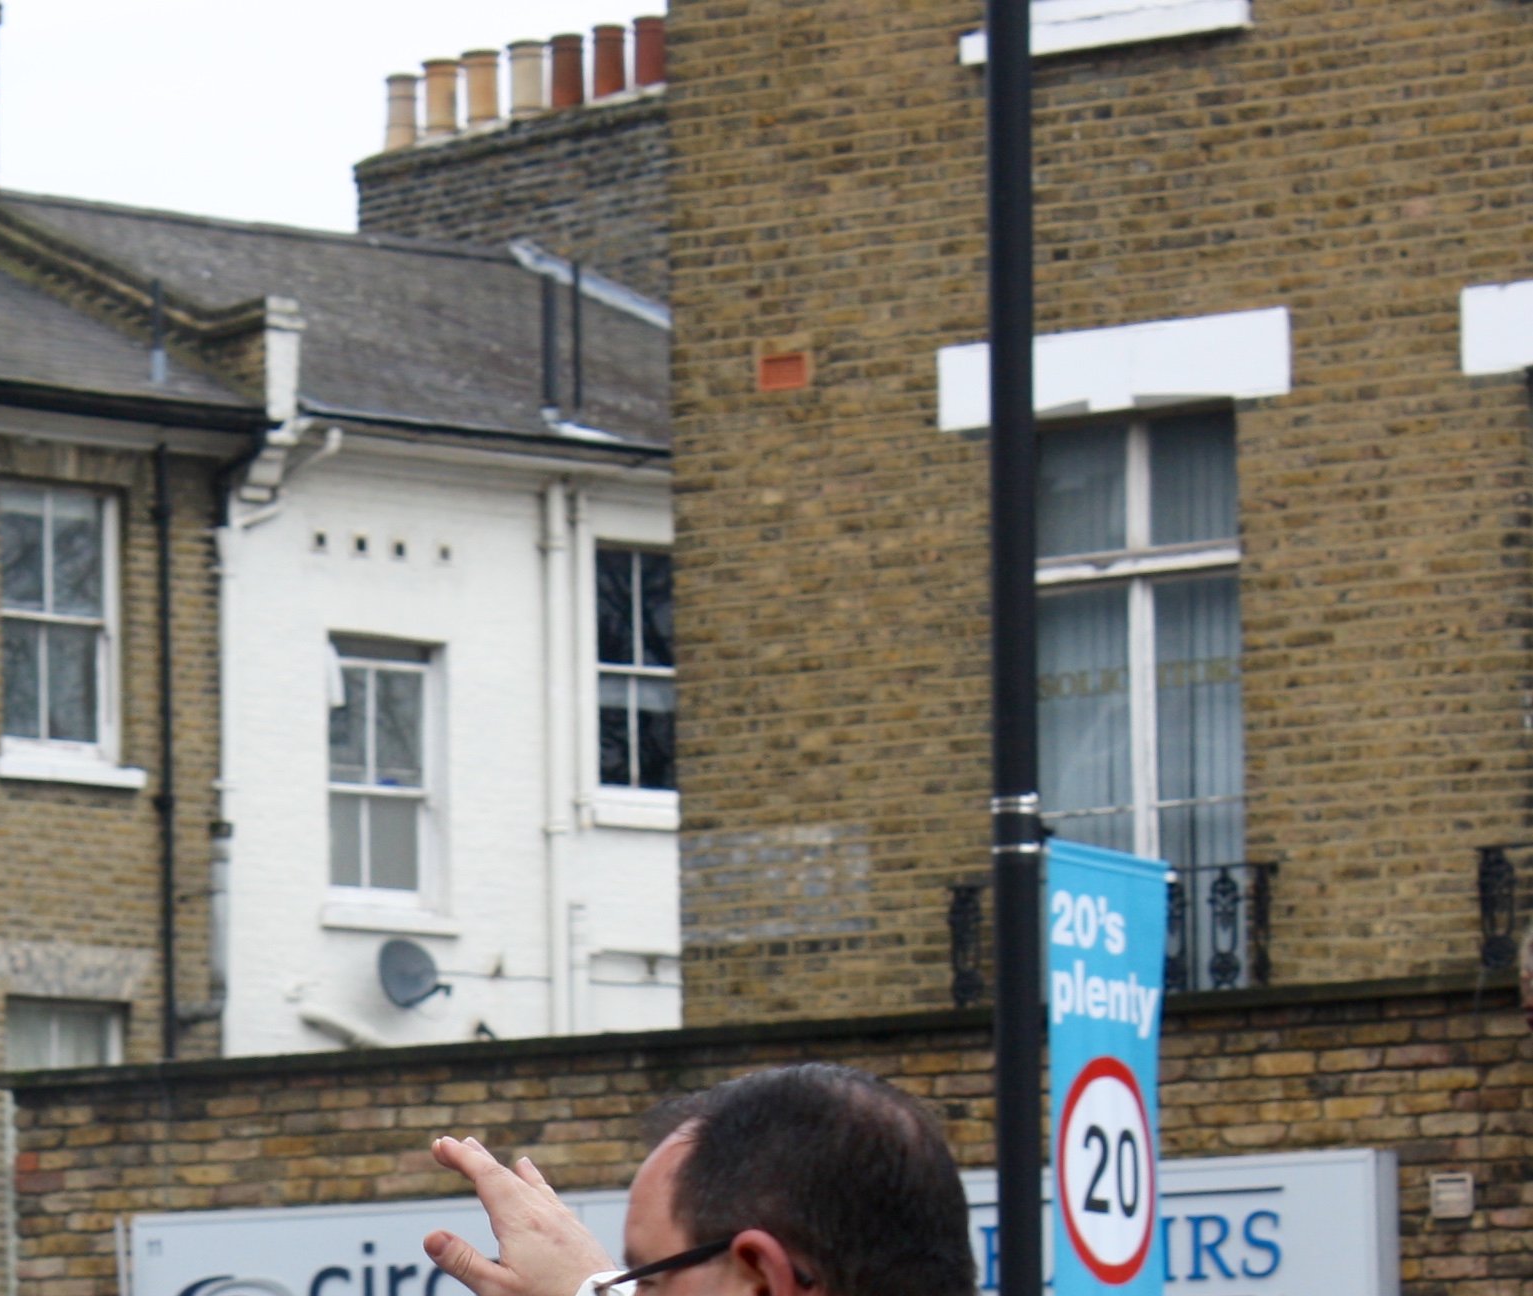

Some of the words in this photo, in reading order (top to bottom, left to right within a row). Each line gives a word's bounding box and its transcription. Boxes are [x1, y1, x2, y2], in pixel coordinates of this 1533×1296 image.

[1051, 889, 1126, 955] 20's
[1051, 959, 1160, 1040] plenty
[1082, 1124, 1139, 1217] 20
